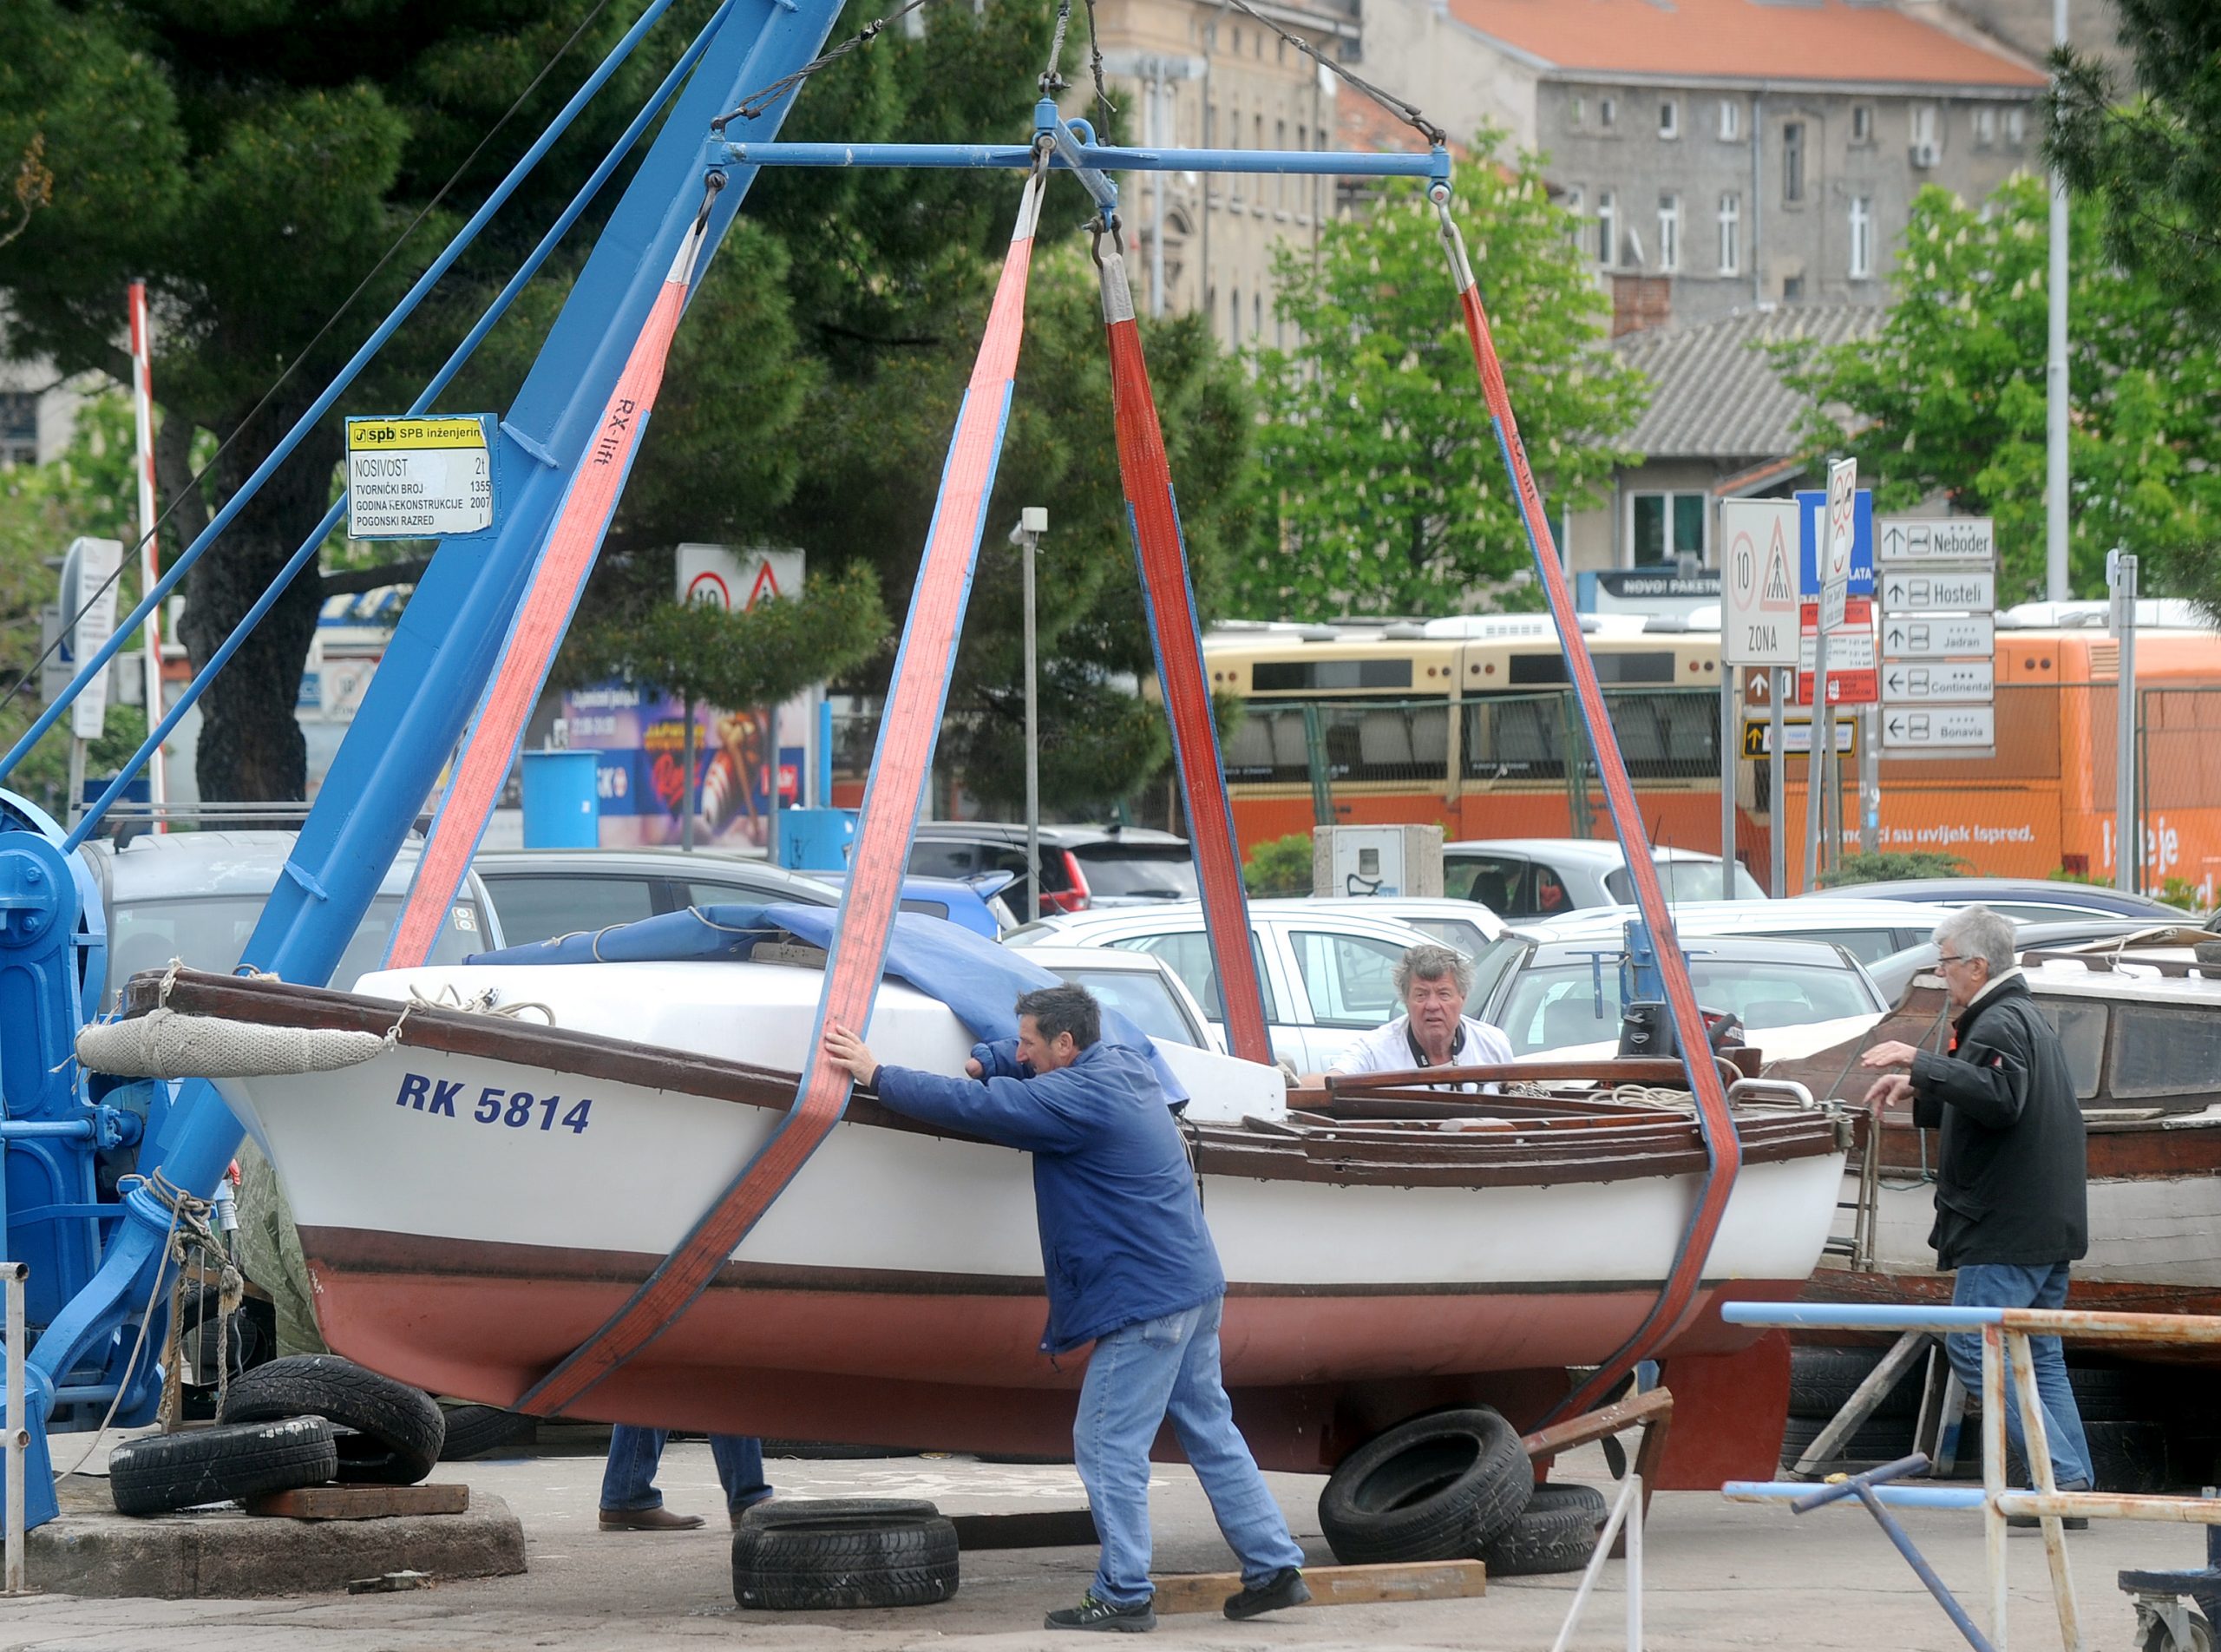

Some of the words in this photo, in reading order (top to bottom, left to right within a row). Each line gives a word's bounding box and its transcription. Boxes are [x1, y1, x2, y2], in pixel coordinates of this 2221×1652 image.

[369, 427, 396, 443] spb
[399, 429, 423, 438] SPB
[593, 398, 635, 465] RX-lift
[355, 458, 409, 478] NOSIVOST
[475, 457, 485, 475] 2t
[356, 482, 399, 495] TVORNIČKI
[402, 483, 423, 495] BROJ
[470, 481, 491, 493] 1355
[356, 501, 388, 511] GODINA
[389, 499, 463, 511] REKONSTRUKCIJE
[470, 497, 490, 509] 2007
[357, 516, 399, 527] POGONSKI
[402, 515, 435, 527] RAZRED
[1934, 532, 1989, 553] Neboder
[1737, 552, 1749, 590] 10
[1623, 579, 1667, 594] NOVO!
[1934, 583, 1981, 604] Hosteli
[1748, 626, 1778, 652] ZONA
[1944, 638, 1980, 648] Jadran
[1931, 682, 1992, 693] Continental
[1941, 726, 1983, 738] Bonavia
[396, 1072, 466, 1118] RK
[474, 1087, 593, 1135] 5814
